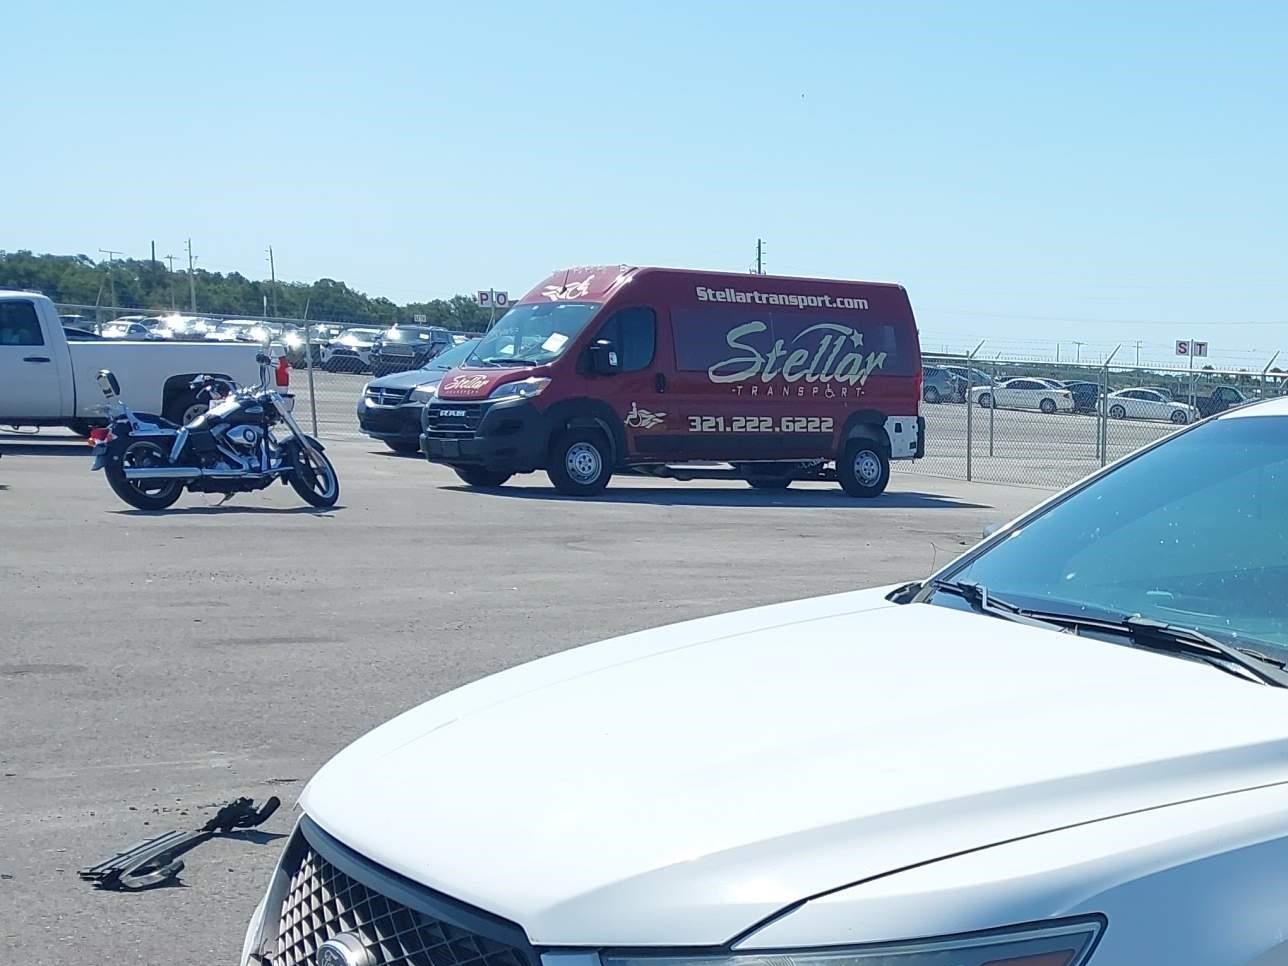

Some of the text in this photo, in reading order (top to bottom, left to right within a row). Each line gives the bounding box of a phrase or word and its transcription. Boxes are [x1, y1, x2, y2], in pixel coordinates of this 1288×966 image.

[480, 292, 489, 306] P
[696, 286, 869, 310] Stellartransport.com
[707, 320, 887, 387] Stellar
[1178, 342, 1205, 355] S T
[687, 416, 834, 433] 321.222.6222
